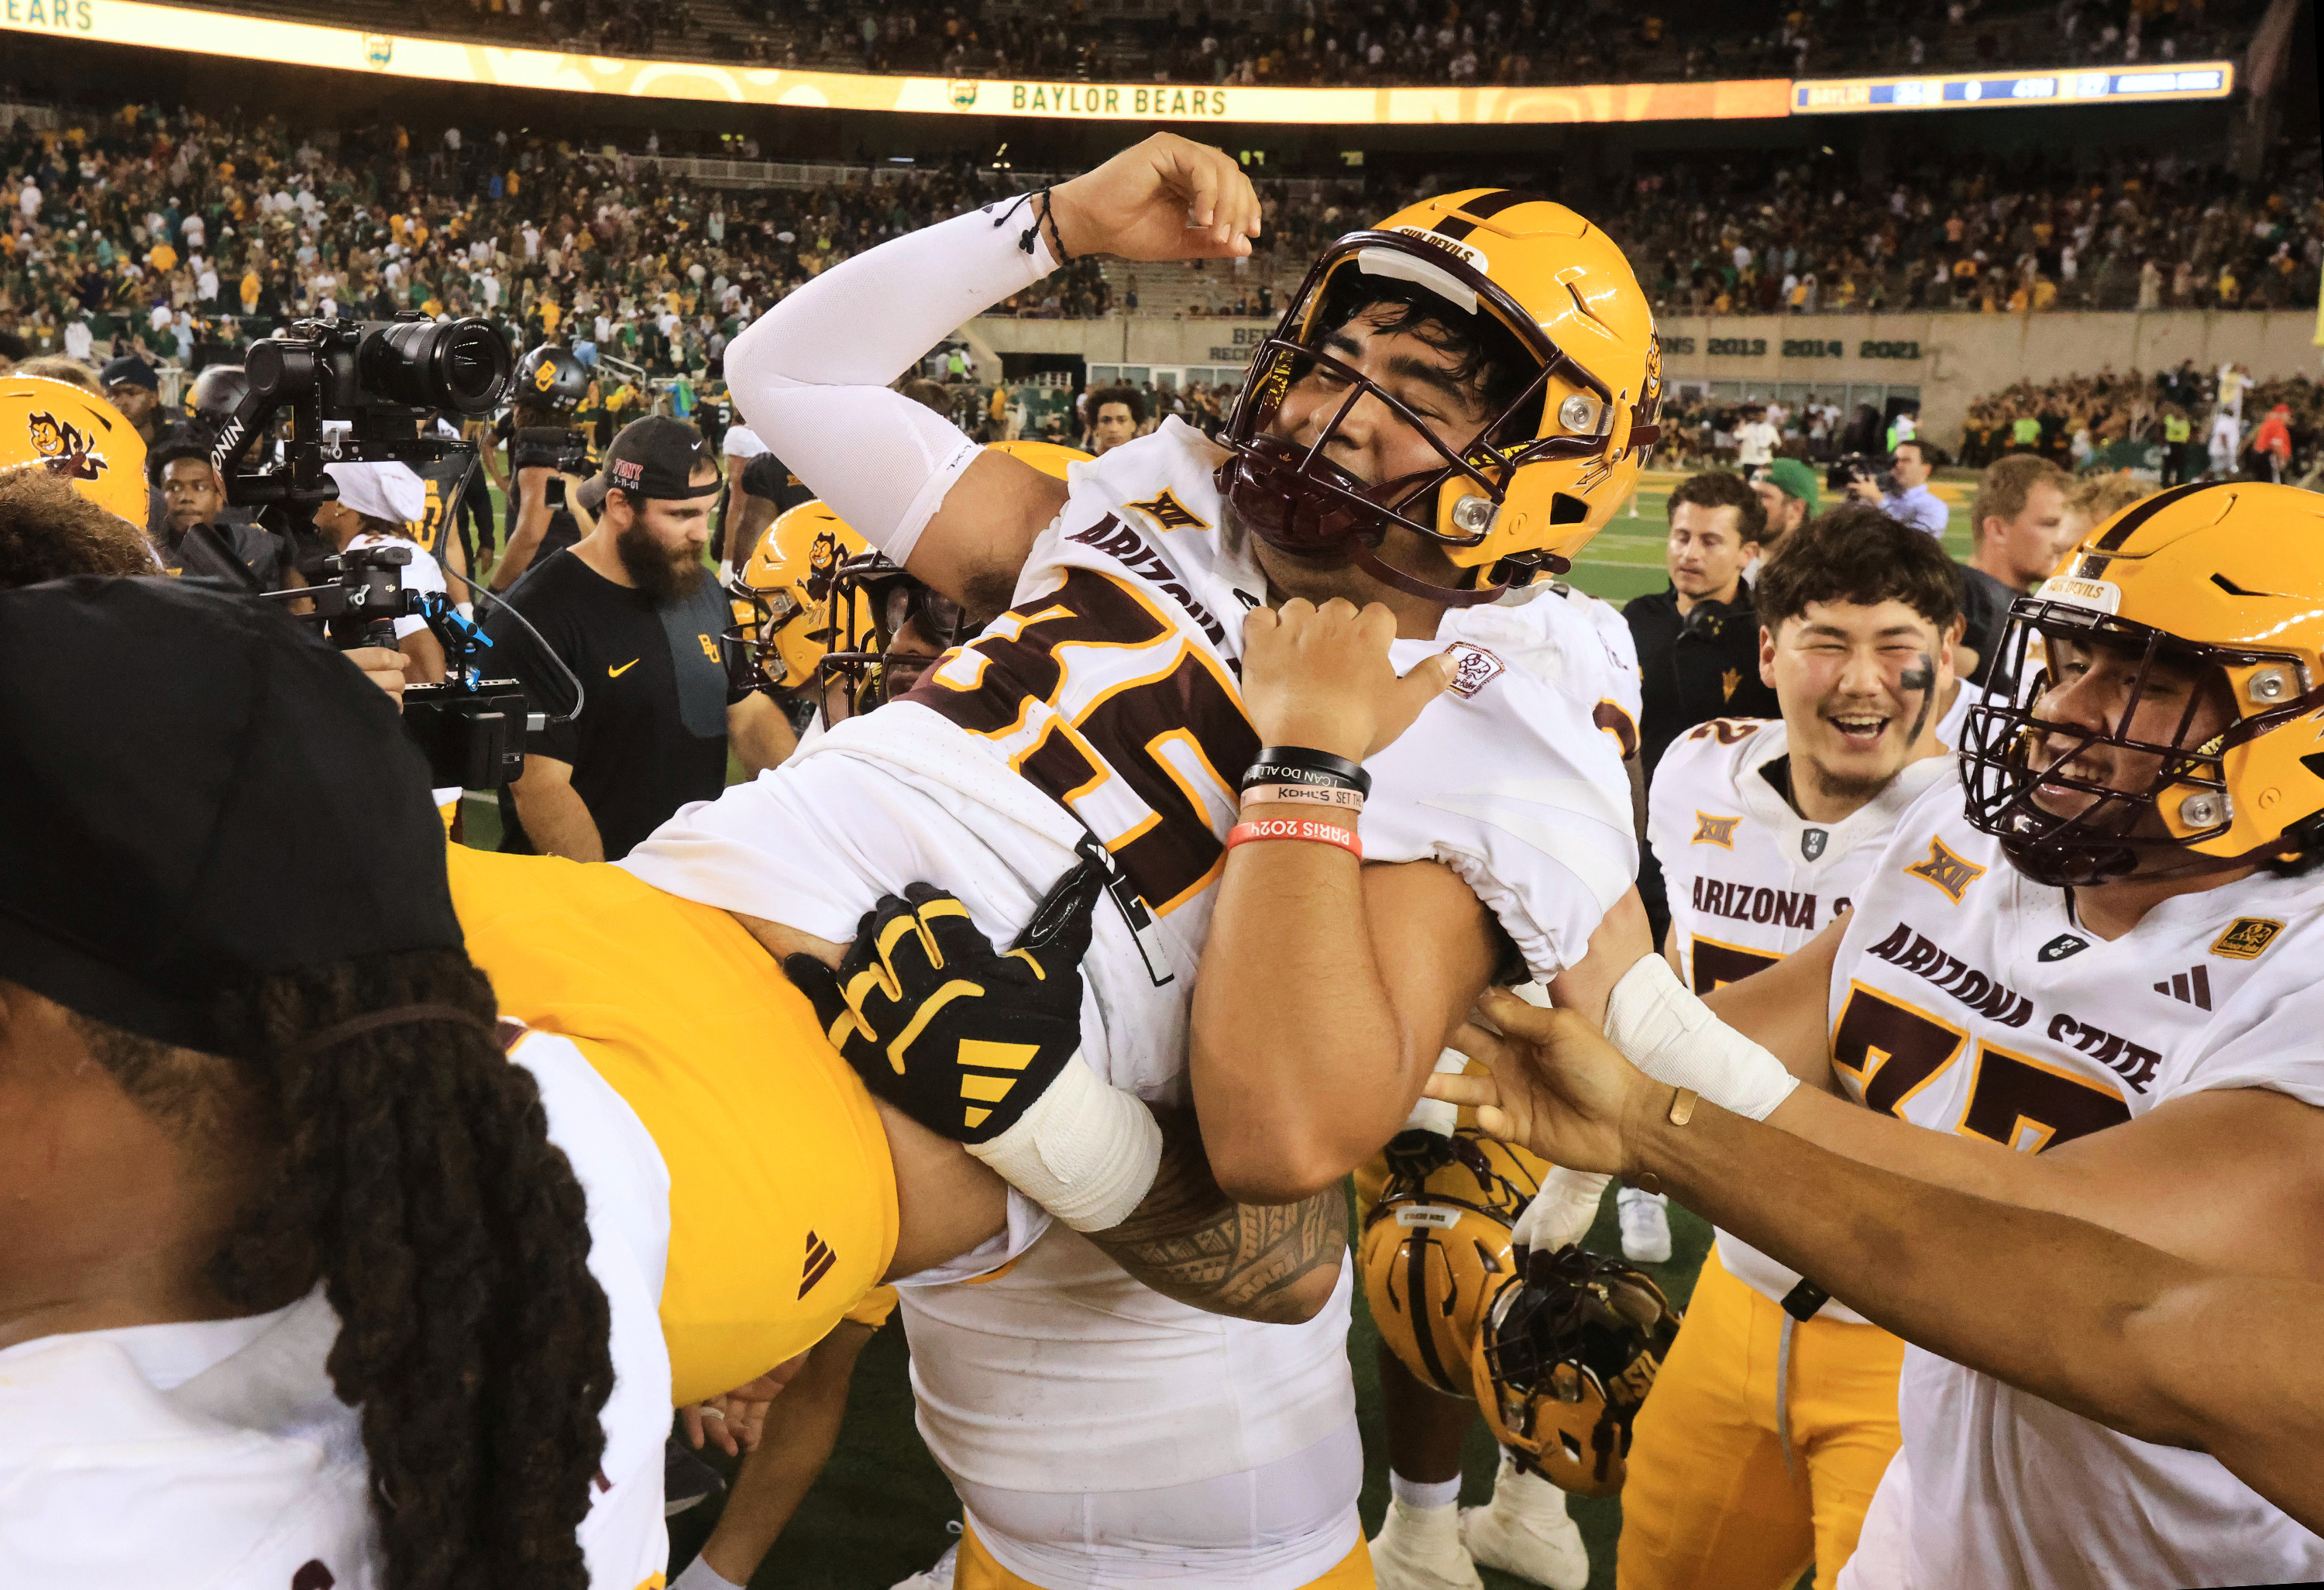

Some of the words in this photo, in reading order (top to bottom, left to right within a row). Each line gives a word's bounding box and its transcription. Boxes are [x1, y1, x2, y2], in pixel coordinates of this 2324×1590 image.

[1012, 84, 1114, 113] BAYLOR
[1135, 89, 1226, 115] BEARS
[1707, 337, 1767, 356] 2013
[1783, 339, 1843, 359] 2014
[1859, 340, 1920, 359] 2021
[612, 458, 644, 480] FDNY
[697, 634, 720, 663] BU
[1260, 766, 1280, 776] ALL
[1281, 766, 1301, 780] DO
[1304, 771, 1331, 786] CAN
[1336, 791, 1351, 805] SET
[1250, 821, 1298, 837] 2024
[1692, 812, 1741, 848] XII
[1908, 839, 1985, 902] XII
[1692, 875, 1817, 931] ARIZONA
[1865, 922, 2034, 1029] ARIZONA
[2047, 1013, 2163, 1095] STATE
